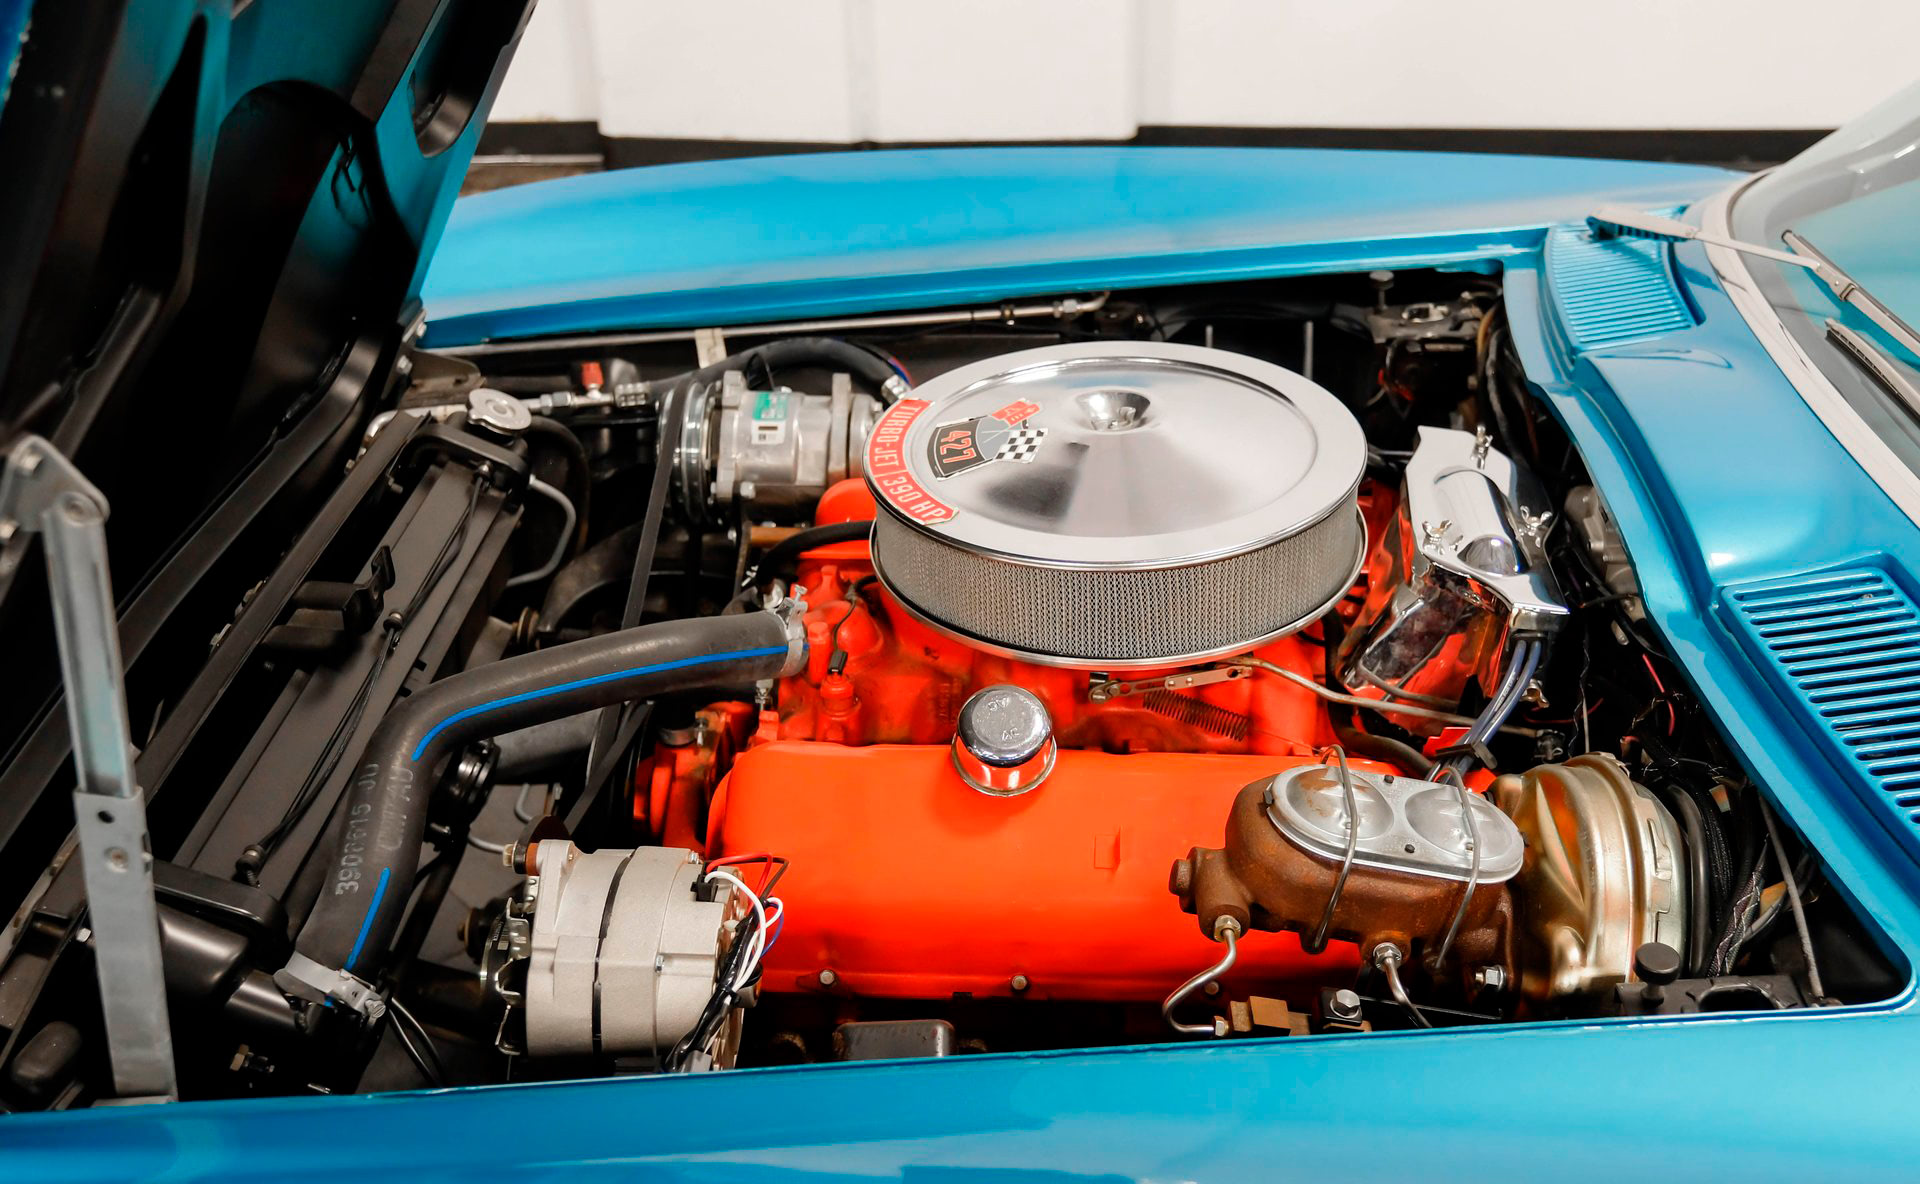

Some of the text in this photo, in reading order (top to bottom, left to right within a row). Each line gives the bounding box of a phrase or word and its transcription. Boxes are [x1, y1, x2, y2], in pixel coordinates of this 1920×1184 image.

[875, 405, 946, 519] TURBO-JET 390 HP
[939, 430, 977, 463] 427
